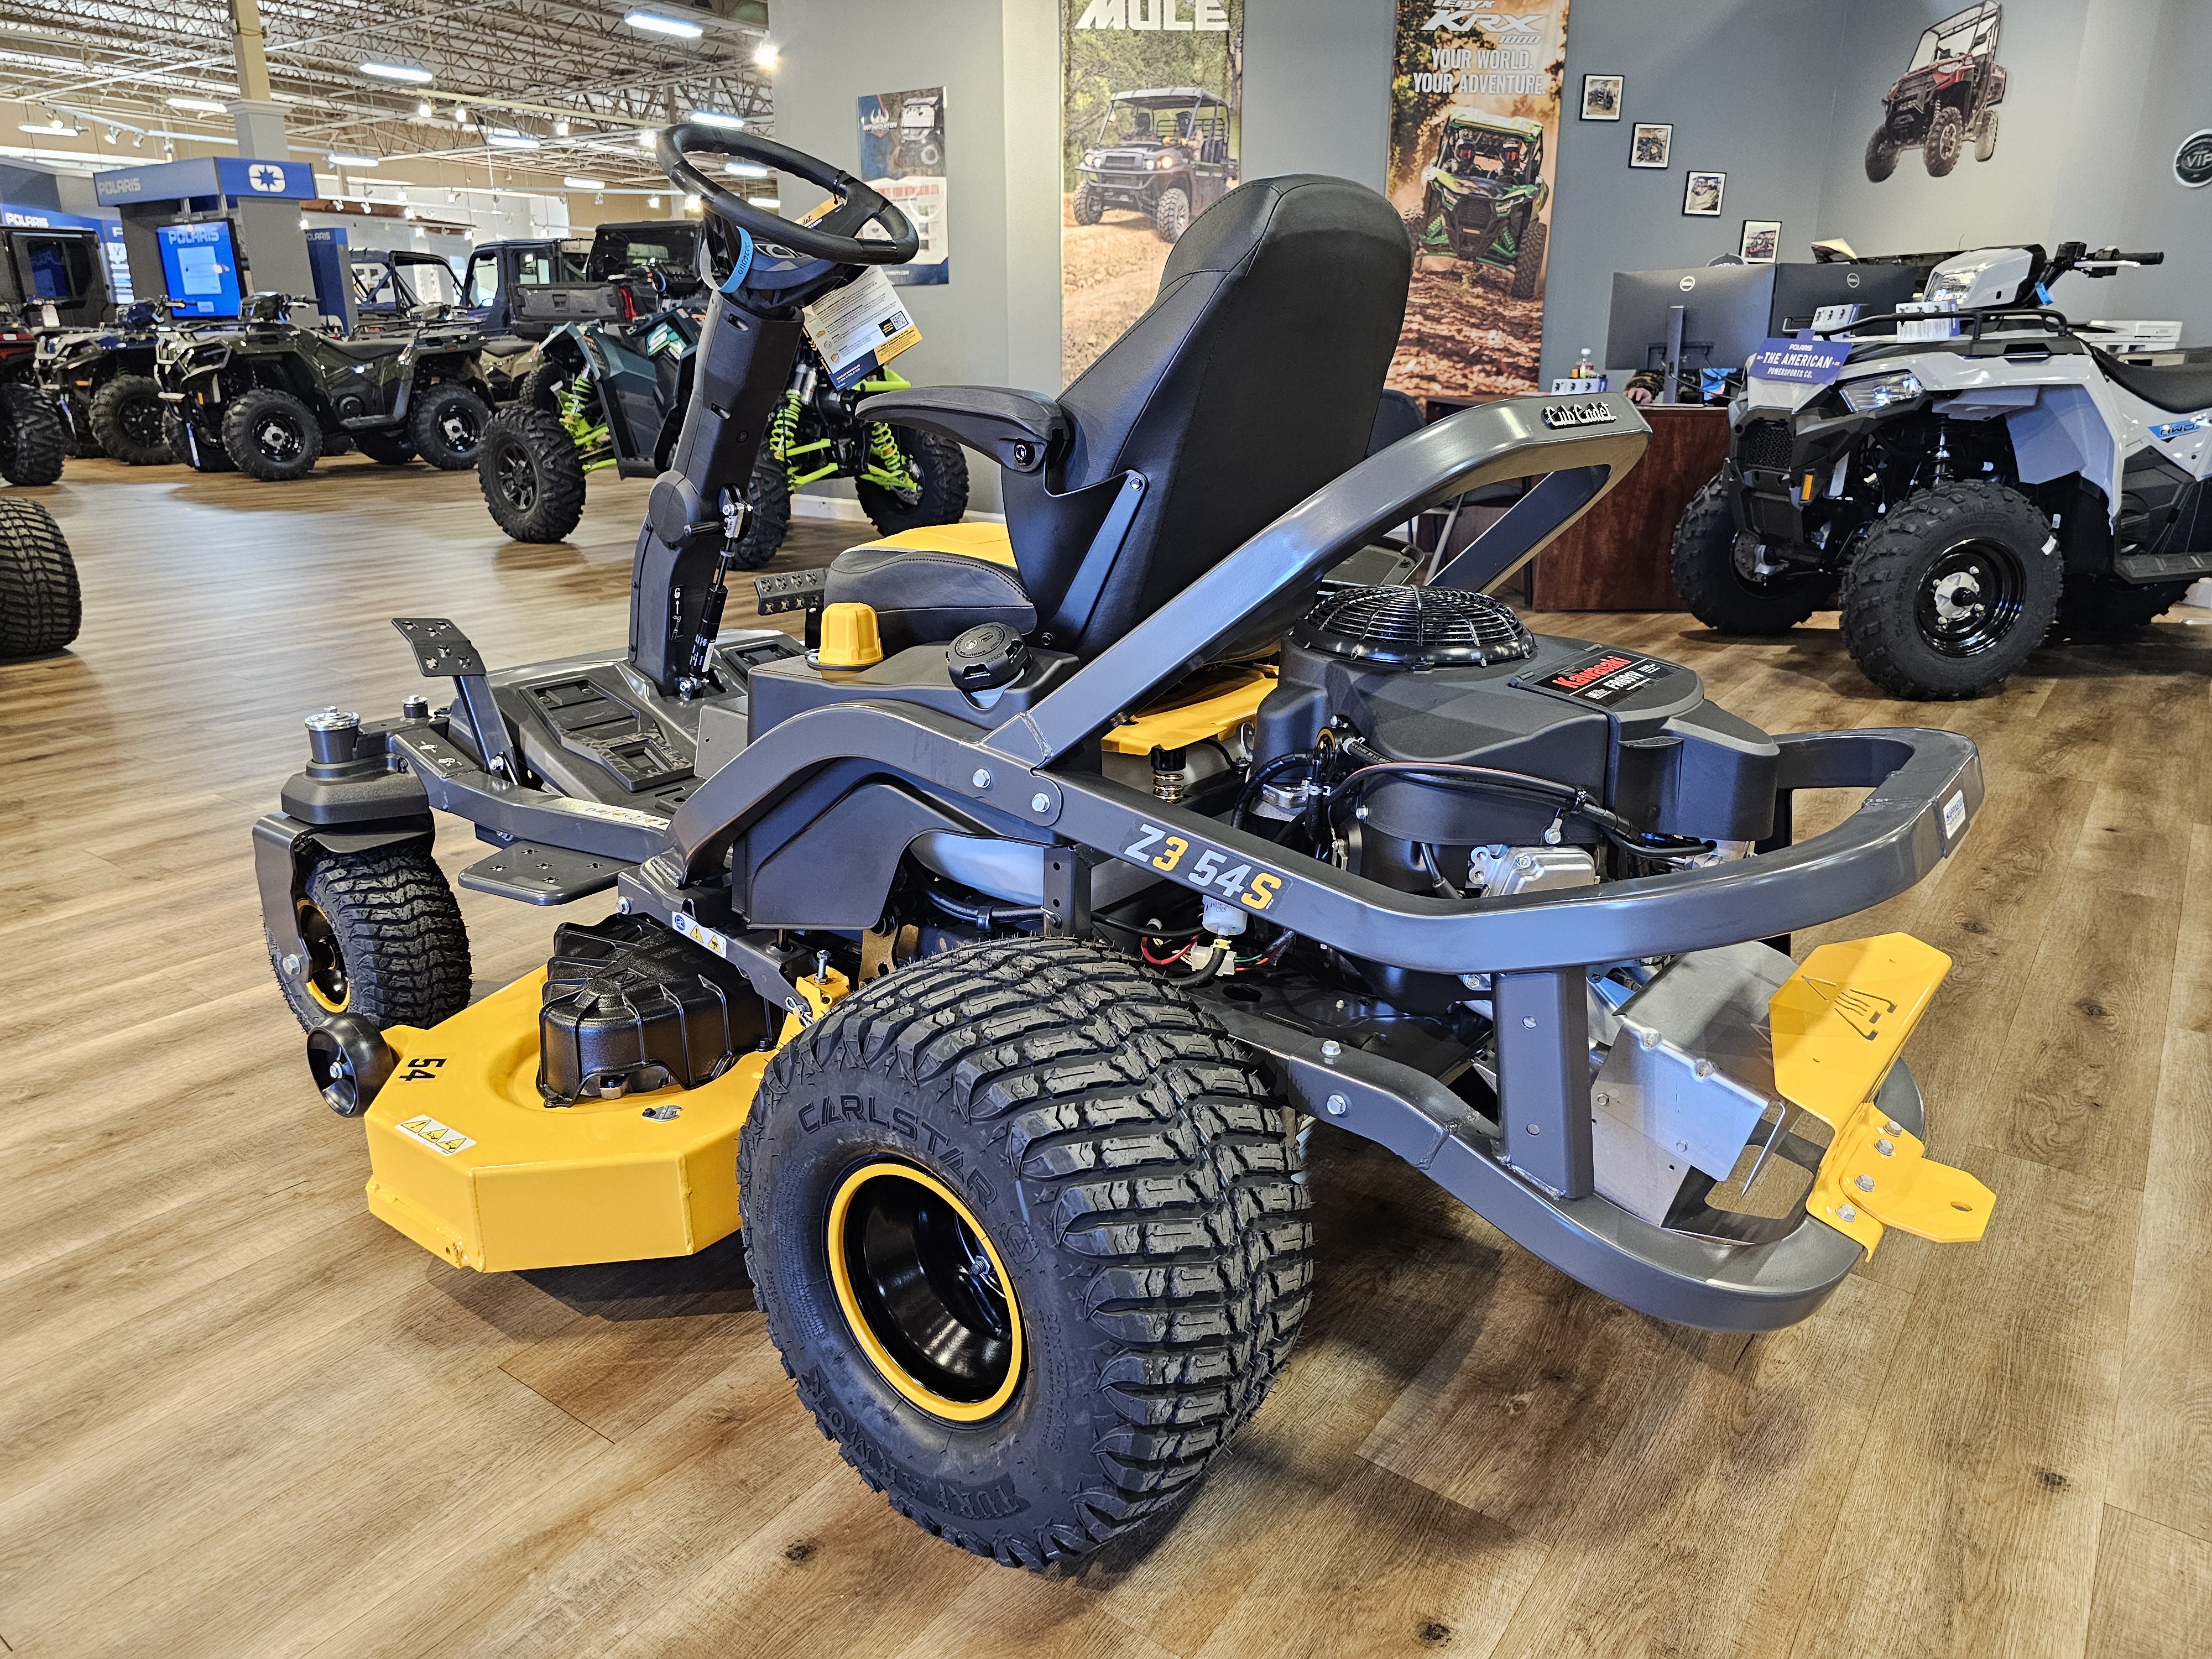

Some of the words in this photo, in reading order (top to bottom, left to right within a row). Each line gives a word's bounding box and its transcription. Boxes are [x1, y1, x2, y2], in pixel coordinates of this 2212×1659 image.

[1074, 0, 1229, 30] MULE
[1420, 9, 1545, 33] KRX
[1498, 34, 1542, 45] 1000
[1431, 48, 1472, 70] YOUR
[1477, 49, 1533, 70] WORLD.
[1413, 72, 1454, 94] YOUR
[1458, 74, 1547, 95] ADVENTURE.
[2186, 153, 2212, 168] VIP
[98, 178, 142, 196] POLARIS
[5, 212, 49, 228] POLARIS
[168, 227, 220, 245] POLARIS
[1763, 351, 1781, 365] THE
[1781, 353, 1833, 369] AMERICAN
[1767, 367, 1803, 378] POWERSPORTS
[1803, 369, 1813, 378] CO.
[1545, 405, 1576, 426] Cub
[1573, 401, 1617, 424] Cadet
[1552, 655, 1632, 689] Kawasaki
[1124, 823, 1188, 872] Z3
[1188, 849, 1282, 910] 54S
[398, 1058, 447, 1082] 54
[798, 1093, 997, 1211] CARLSTAR
[935, 1478, 1020, 1521] TURF
